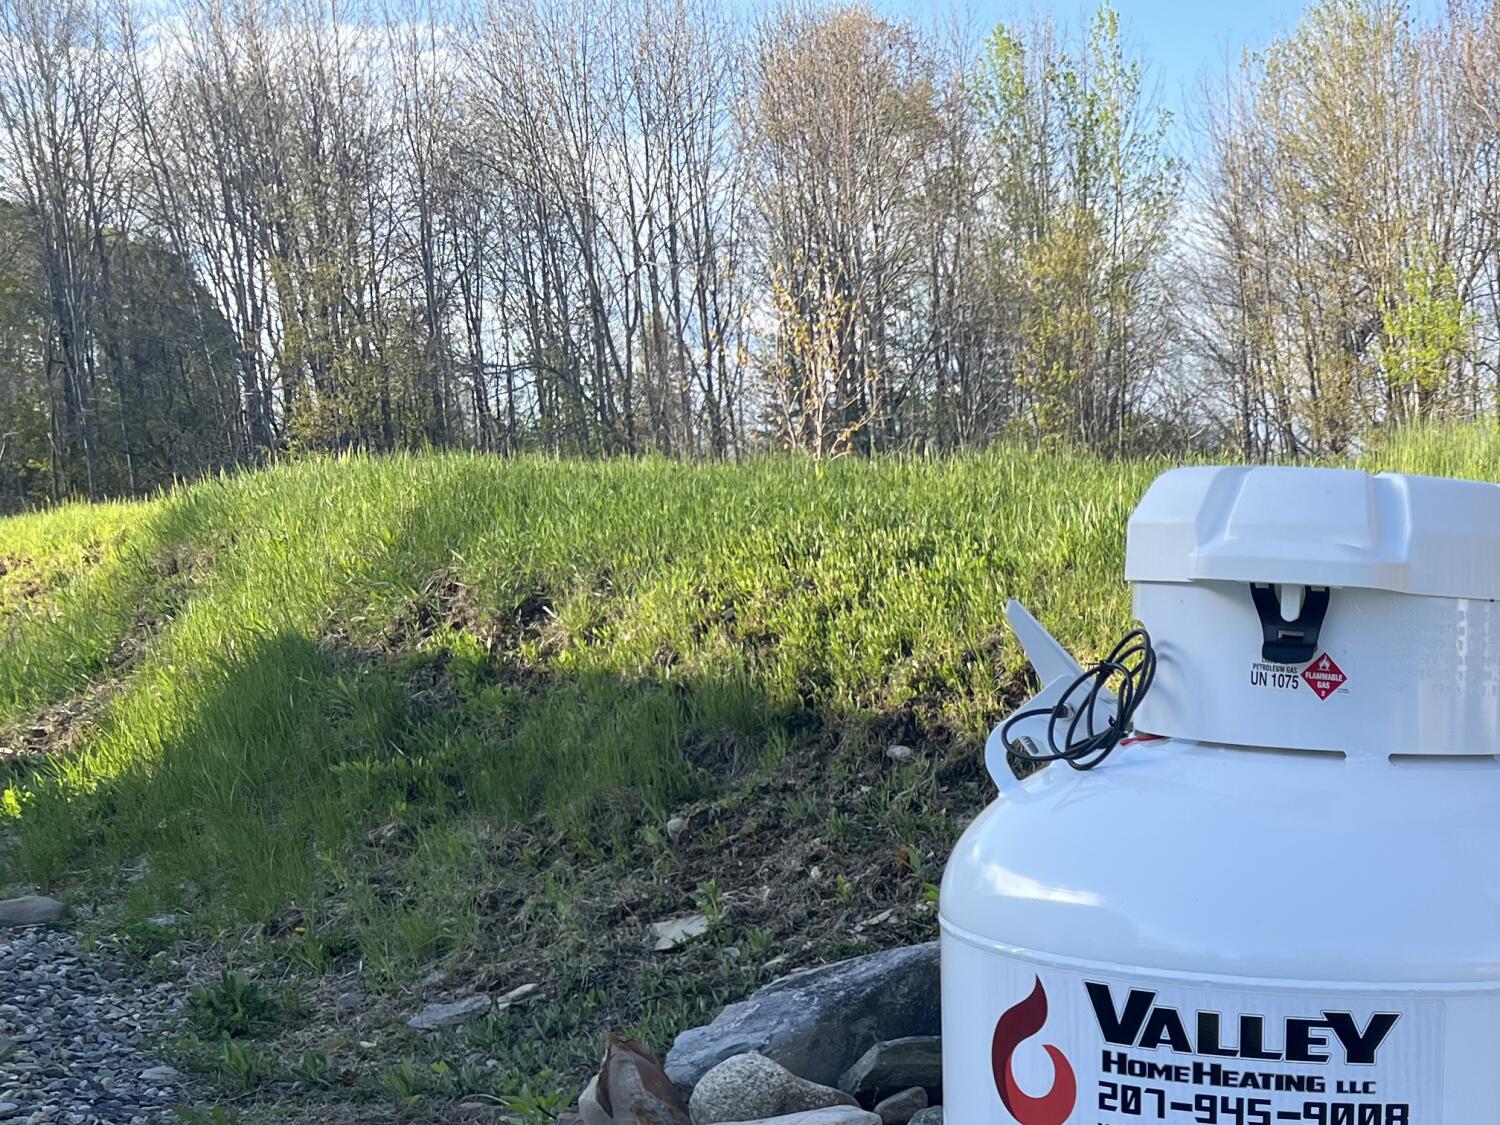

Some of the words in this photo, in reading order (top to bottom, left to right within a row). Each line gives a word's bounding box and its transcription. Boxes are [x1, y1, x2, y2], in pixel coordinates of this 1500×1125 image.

[1252, 663, 1285, 673] PETROLEUM
[1286, 666, 1298, 674] GAS
[1250, 671, 1268, 687] UN
[1272, 673, 1299, 690] 1075
[1305, 671, 1343, 682] FLAMMABLE
[1316, 681, 1330, 689] GAS
[1084, 980, 1401, 1065] VALLEY
[1336, 1080, 1376, 1095] LLC
